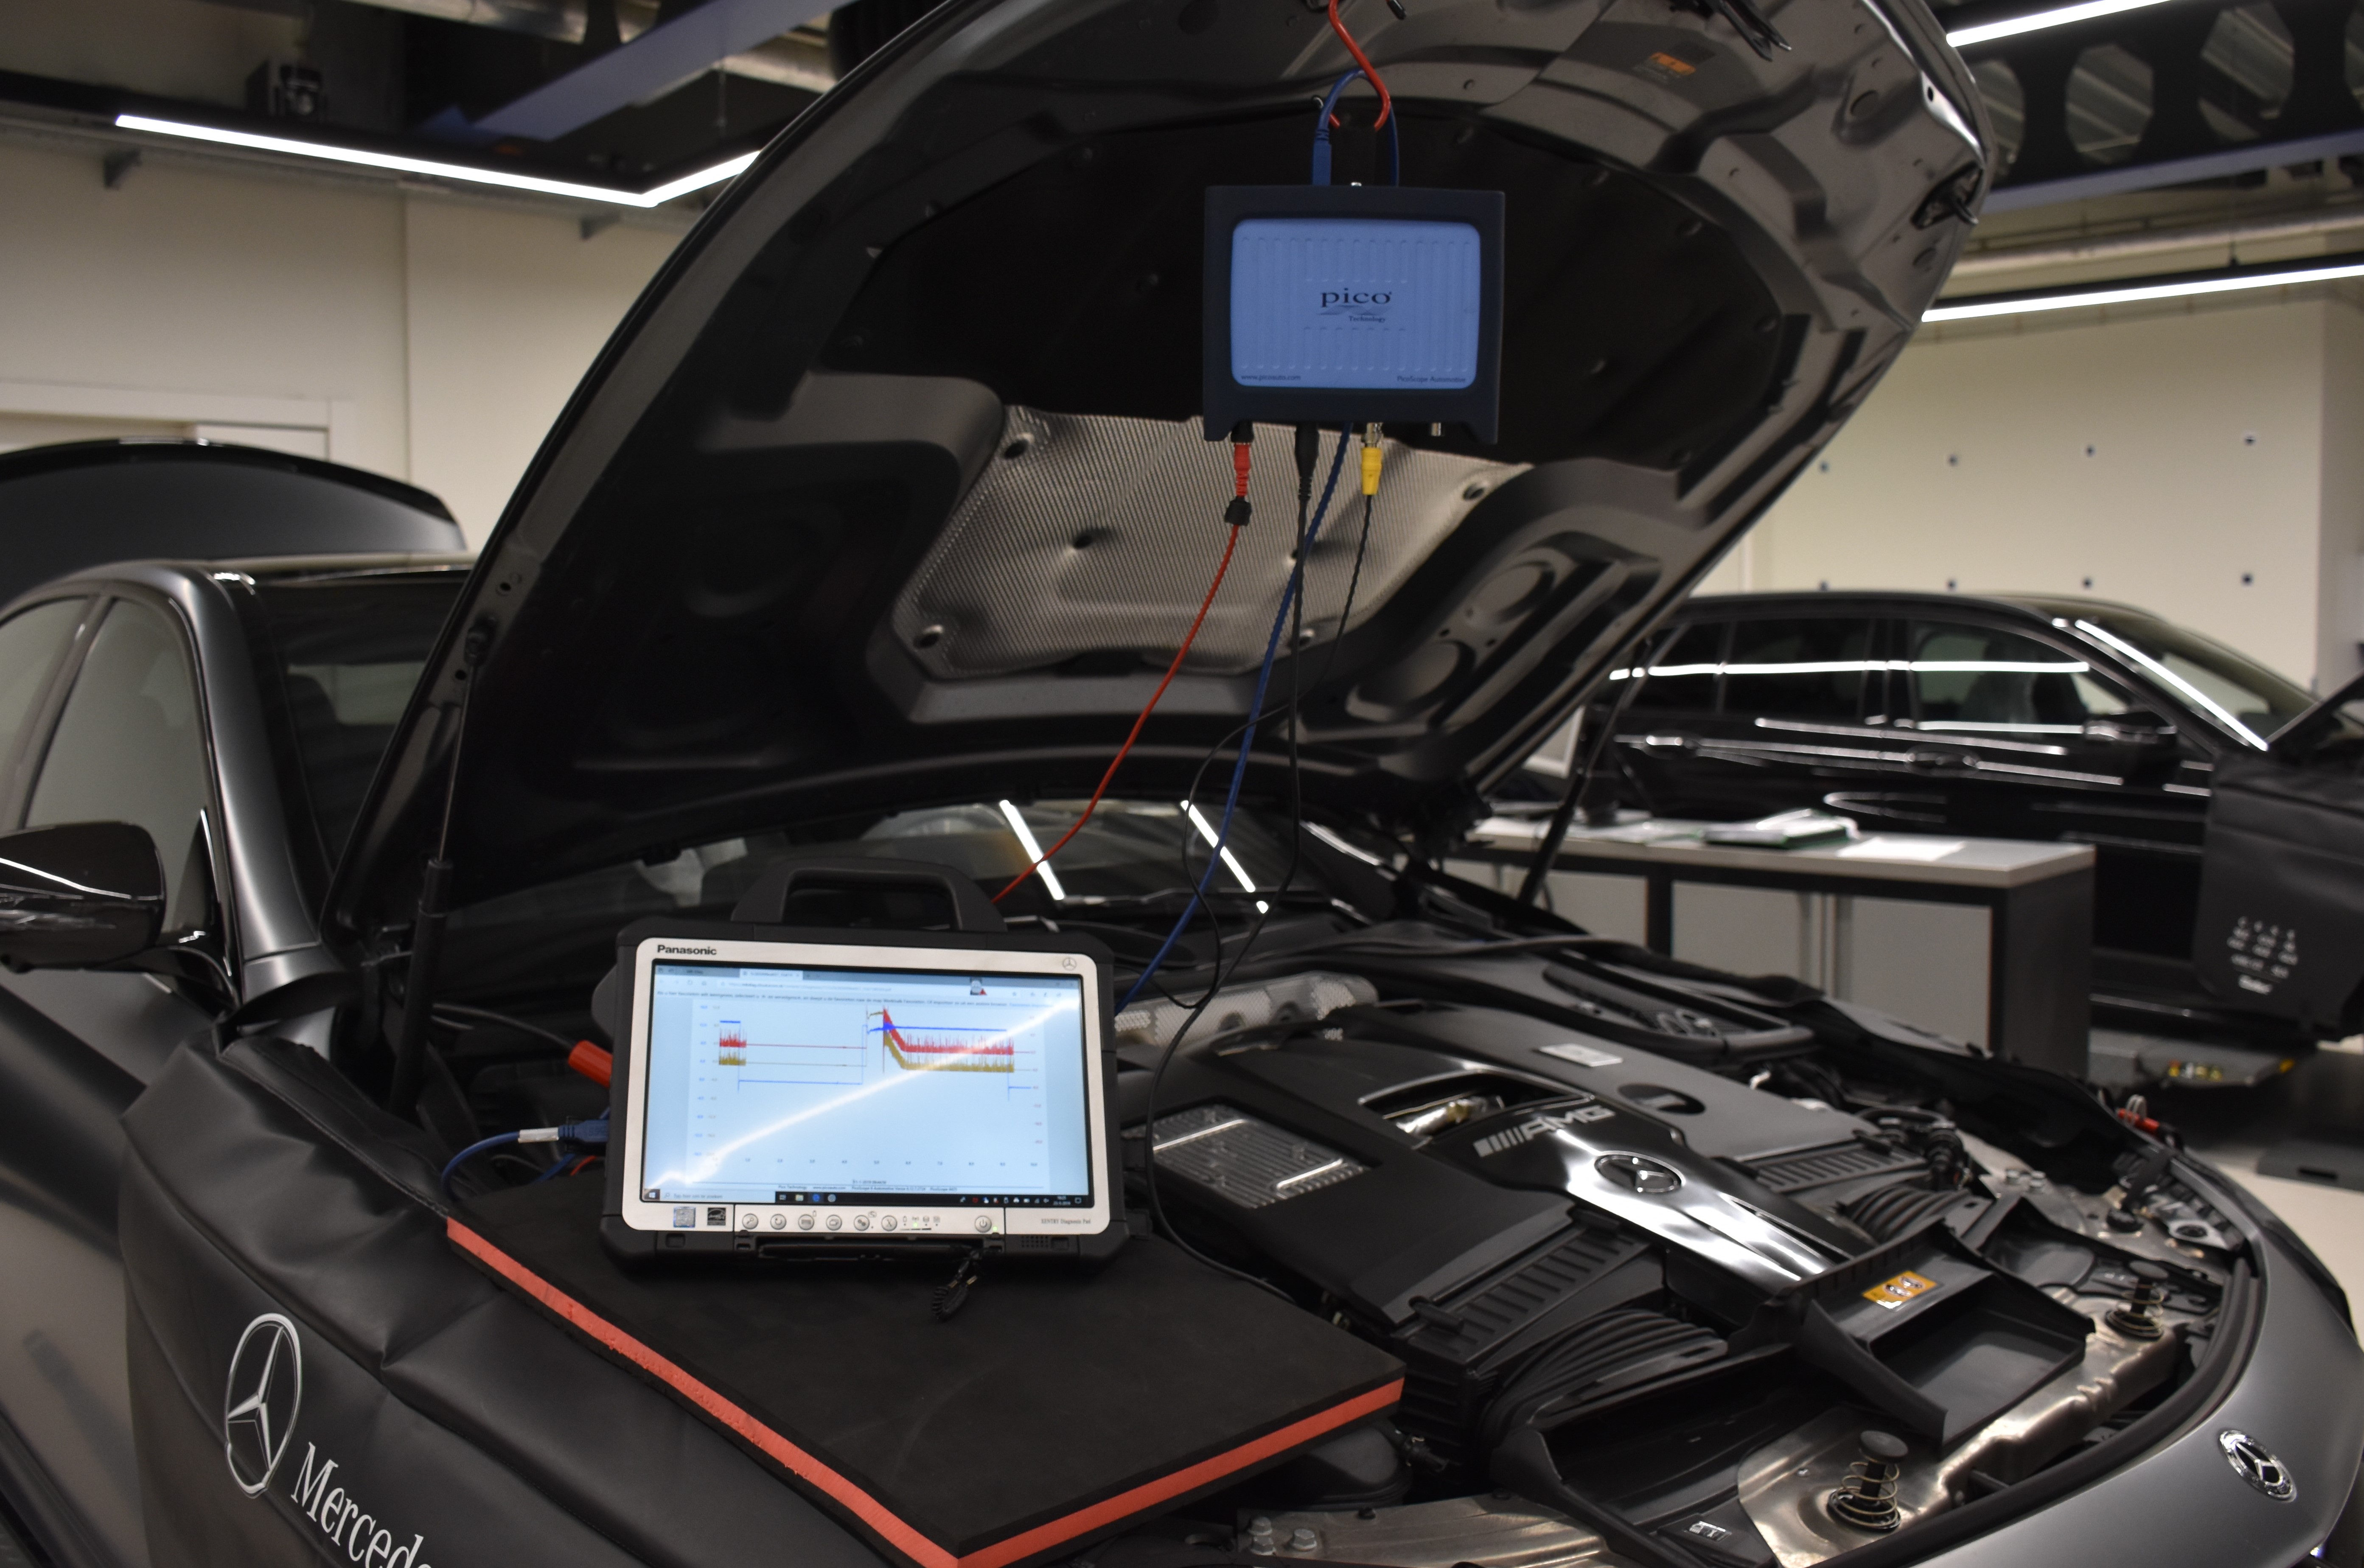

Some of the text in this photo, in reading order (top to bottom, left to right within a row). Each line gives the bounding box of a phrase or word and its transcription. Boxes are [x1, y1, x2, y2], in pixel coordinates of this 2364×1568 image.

[1321, 288, 1392, 308] pico
[657, 945, 717, 956] Panasonic
[1521, 1105, 1615, 1141] AMG
[291, 1442, 432, 1568] Merced
